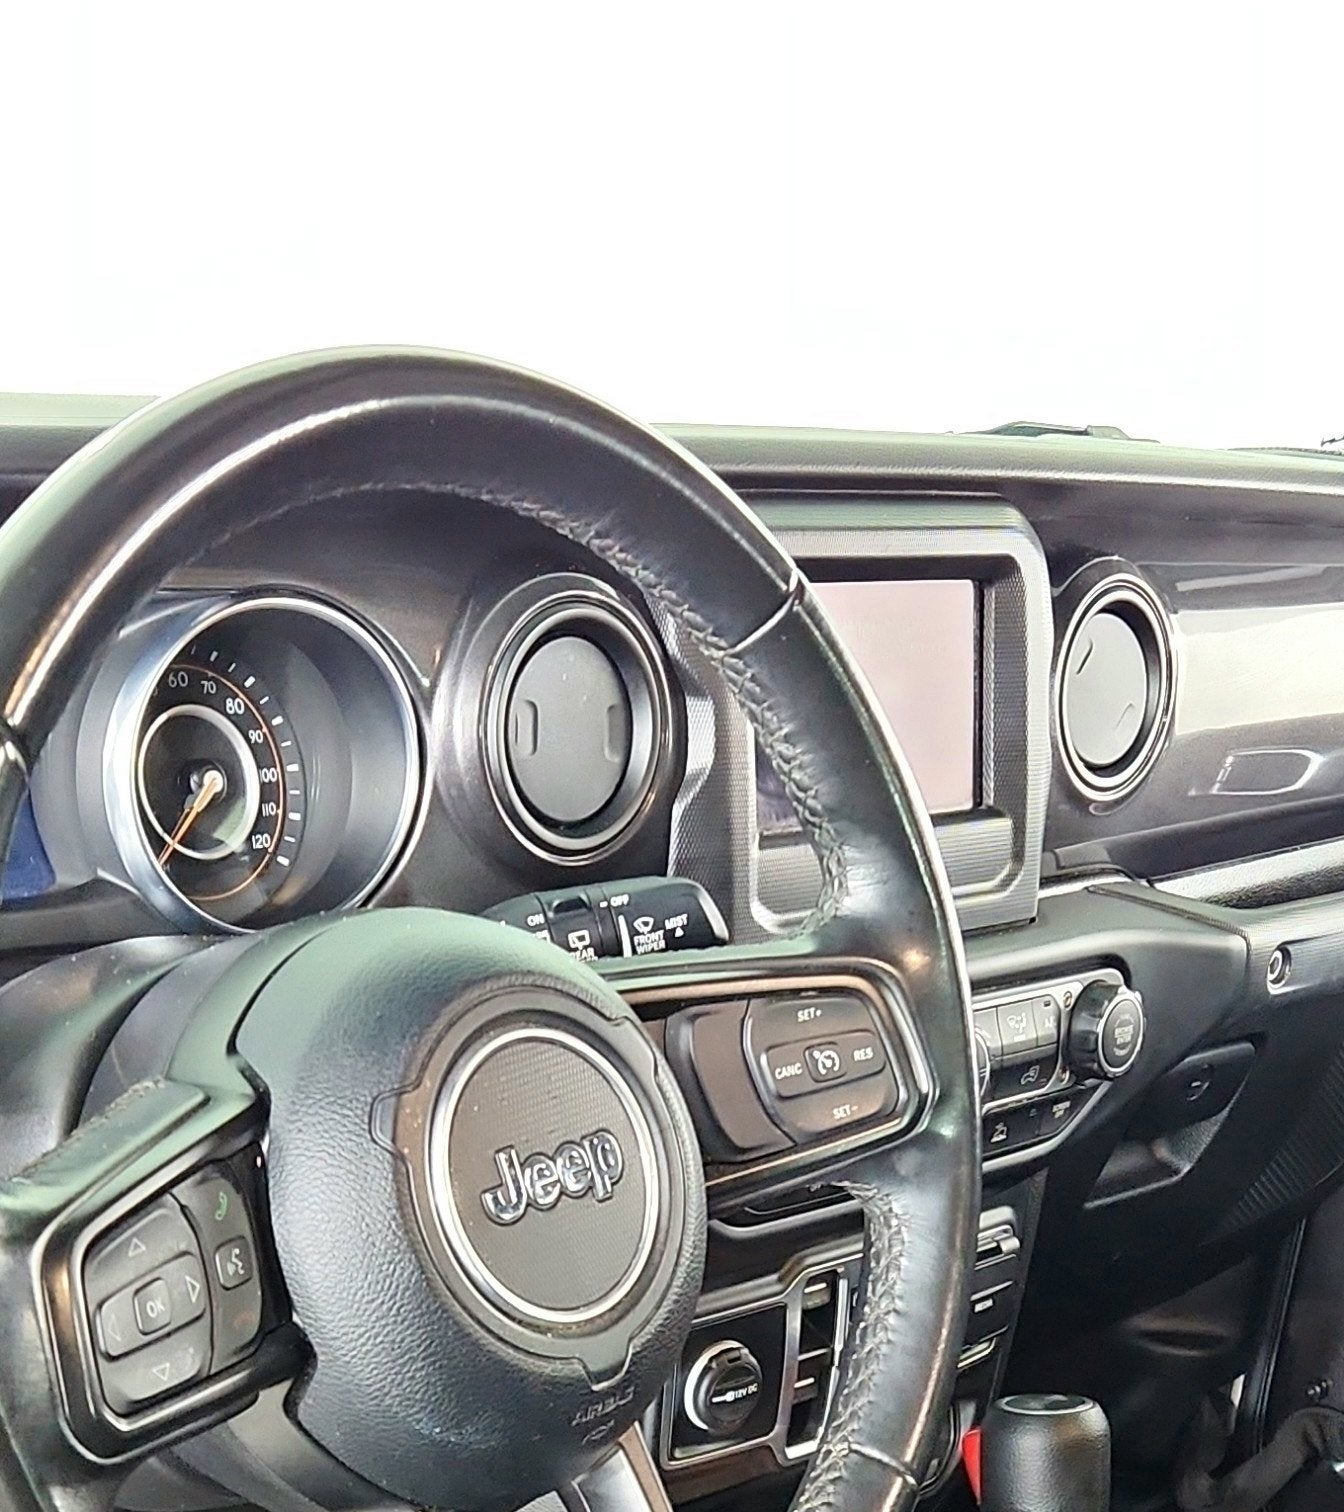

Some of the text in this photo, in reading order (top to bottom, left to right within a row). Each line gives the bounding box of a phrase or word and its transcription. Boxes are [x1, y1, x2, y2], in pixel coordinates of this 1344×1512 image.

[168, 671, 277, 849] 60 70 80 90 100 110 120
[526, 913, 545, 927] ON
[633, 930, 665, 945] FRONT
[636, 940, 666, 954] WIPER
[853, 1047, 874, 1061] RES
[775, 1062, 803, 1080] CANC
[481, 1129, 624, 1226] Jeep
[145, 1297, 166, 1318] OK
